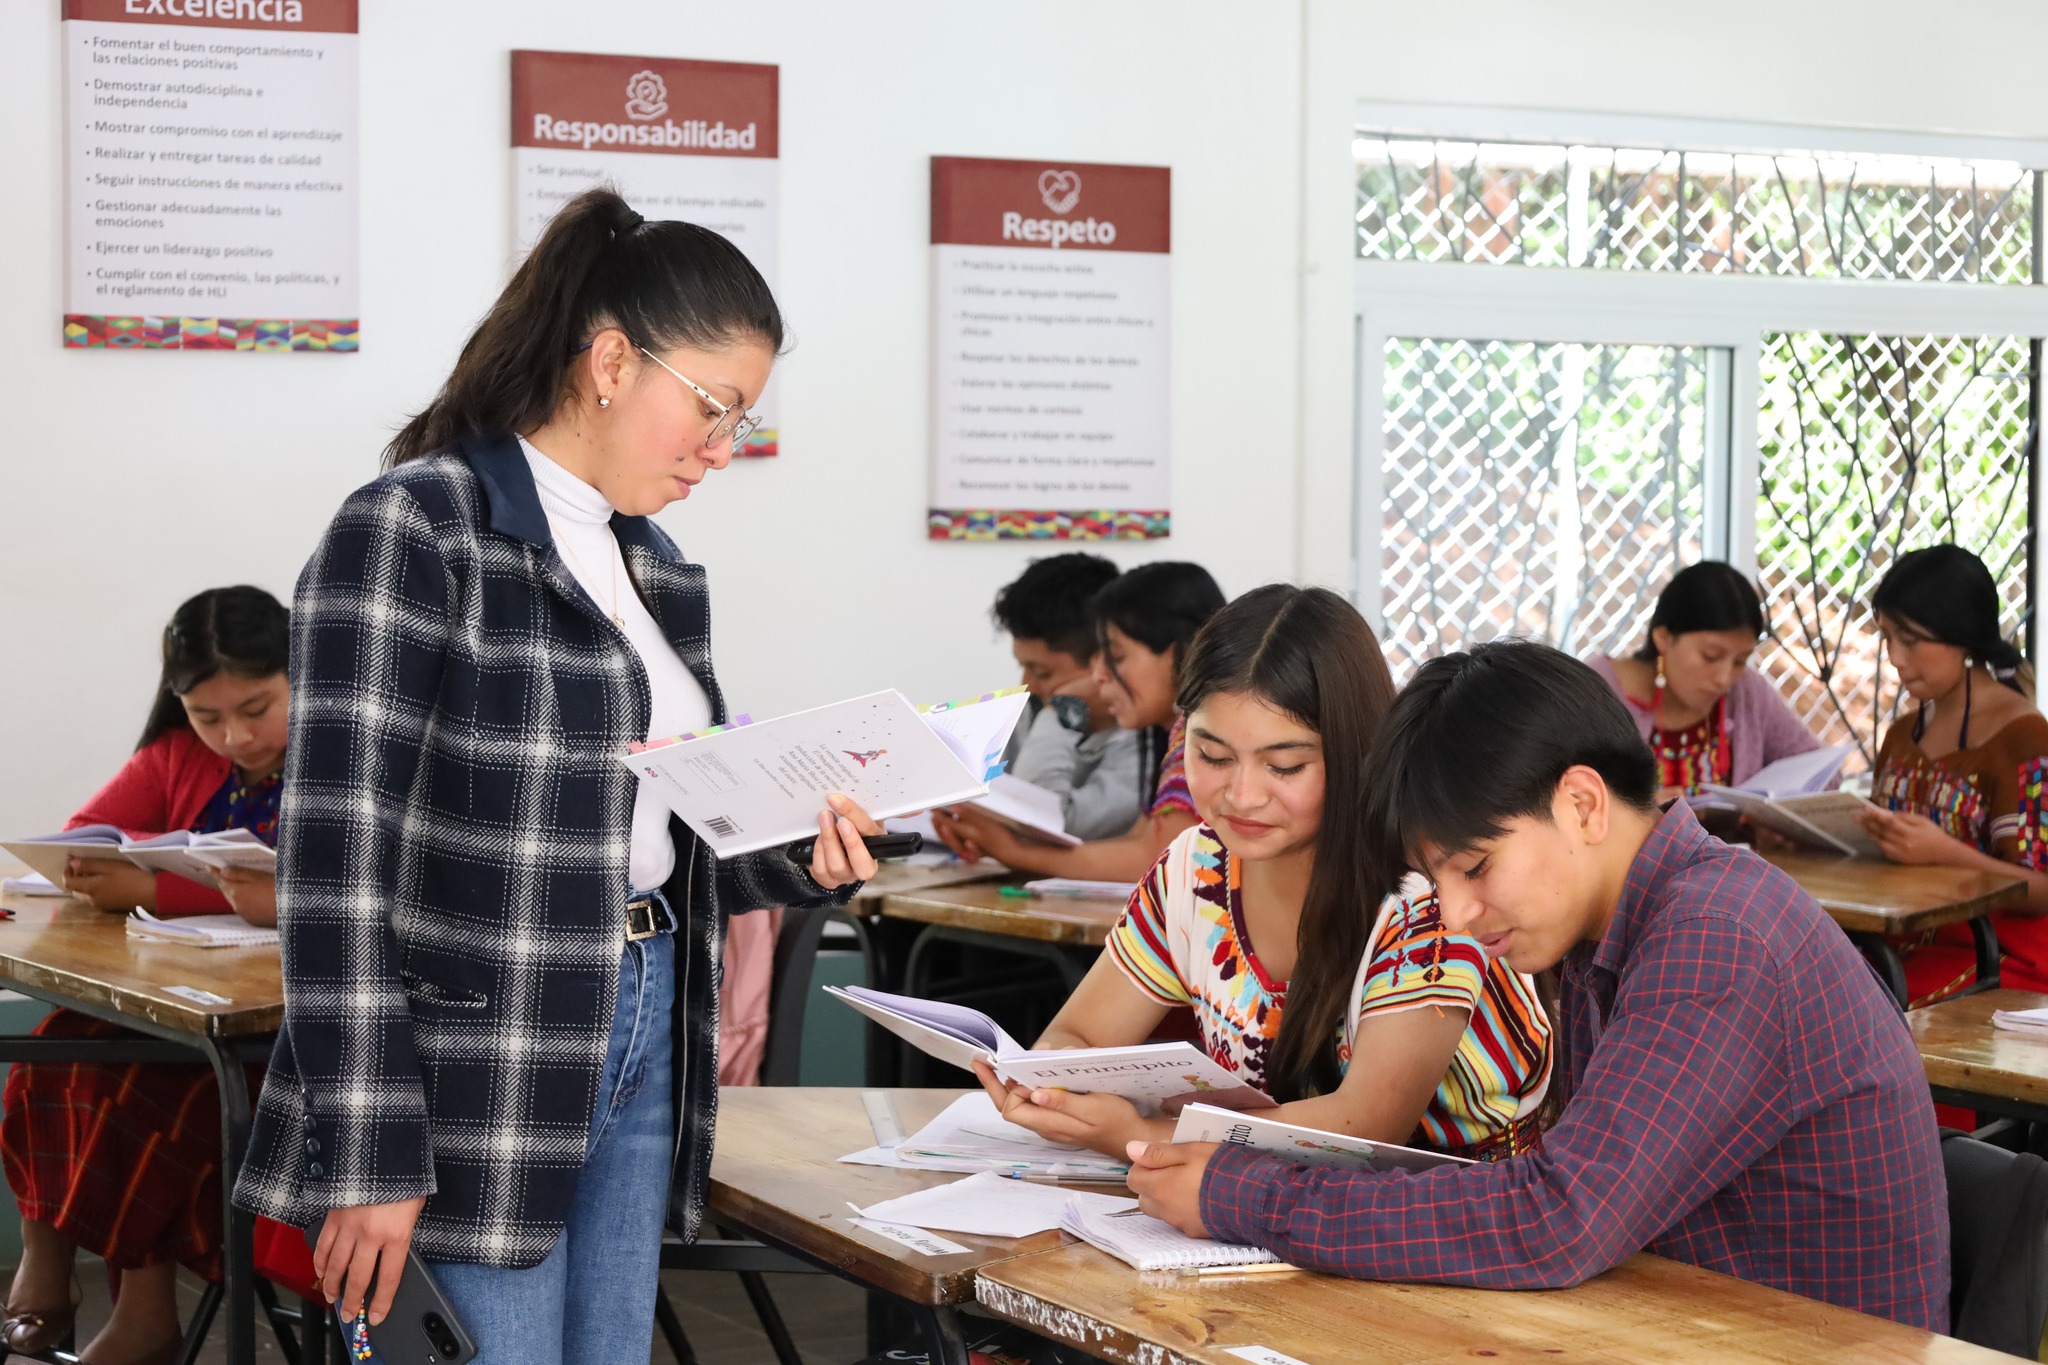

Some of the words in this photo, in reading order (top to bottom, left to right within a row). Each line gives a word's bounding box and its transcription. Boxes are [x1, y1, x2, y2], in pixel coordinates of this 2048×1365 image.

[125, 0, 302, 22] Excelencia
[93, 36, 154, 50] Fomentar
[159, 38, 170, 50] el
[174, 40, 206, 52] buen
[209, 42, 313, 58] comportamiento
[317, 49, 324, 60] y
[93, 52, 111, 64] las
[114, 54, 179, 67] relaciones
[182, 58, 238, 70] positivas
[94, 79, 161, 92] Demostrar
[166, 81, 253, 98] autodisciplina
[256, 88, 264, 97] e
[94, 96, 188, 110] independencia
[94, 121, 146, 134] Mostrar
[150, 124, 228, 139] compromiso
[231, 127, 254, 138] con
[257, 127, 268, 139] el
[272, 129, 343, 142] aprendizaje
[534, 113, 756, 150] Responsabilidad
[95, 147, 145, 160] Realizar
[149, 150, 156, 162] y
[160, 150, 213, 164] entregar
[217, 152, 256, 164] tareas
[258, 154, 274, 165] de
[278, 153, 322, 166] calidad
[94, 173, 134, 188] Seguir
[138, 176, 222, 190] instrucciones
[224, 177, 241, 190] de
[244, 180, 291, 191] manera
[294, 179, 343, 192] efectiva
[96, 199, 158, 212] Gestionar
[161, 201, 262, 216] adecuadamente
[265, 204, 282, 217] las
[96, 216, 164, 228] emociones
[1002, 212, 1116, 250] Respeto
[96, 242, 139, 256] Ejercer
[144, 244, 160, 255] un
[164, 242, 220, 258] liderazgo
[224, 245, 273, 258] positivo
[96, 268, 146, 282] Cumplir
[150, 270, 172, 280] con
[176, 269, 187, 280] el
[255, 271, 272, 283] las
[332, 274, 340, 285] y
[96, 284, 108, 295] el
[112, 284, 184, 299] reglamento
[188, 285, 204, 297] de
[207, 286, 227, 298] HLI
[1032, 1069, 1057, 1078] El
[1065, 1060, 1193, 1076] Principito
[1222, 1124, 1255, 1146] ipito
